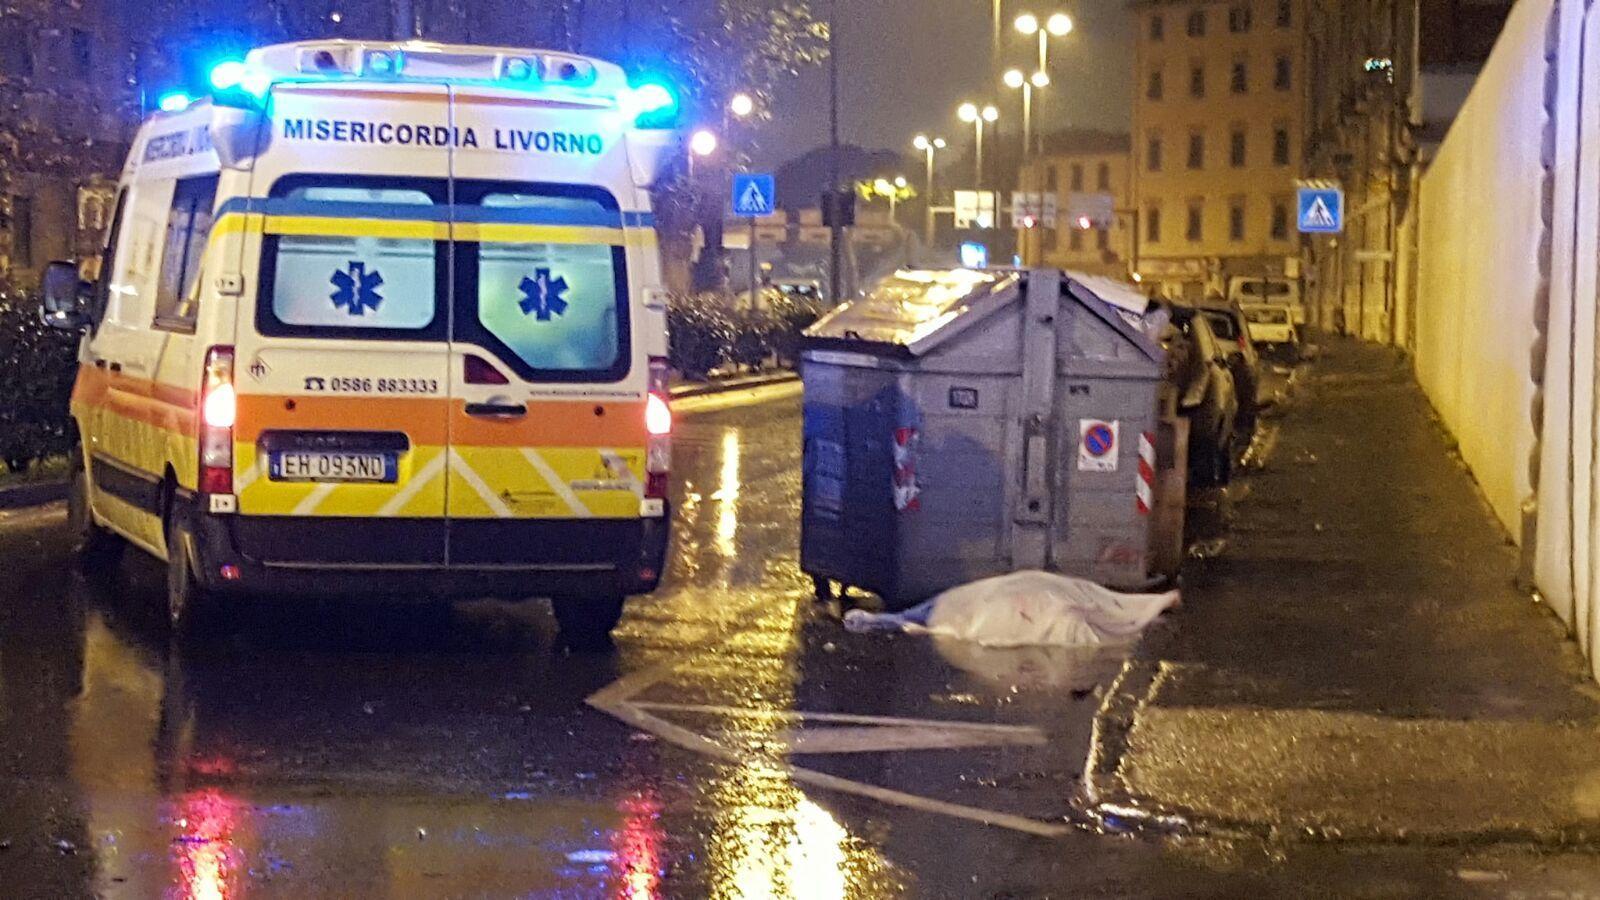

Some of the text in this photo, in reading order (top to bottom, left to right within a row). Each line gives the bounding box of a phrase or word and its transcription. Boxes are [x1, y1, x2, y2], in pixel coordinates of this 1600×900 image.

[284, 118, 604, 155] MISERICORDIA LIVORNO
[331, 377, 438, 393] 0586 883333
[285, 454, 310, 474] EH
